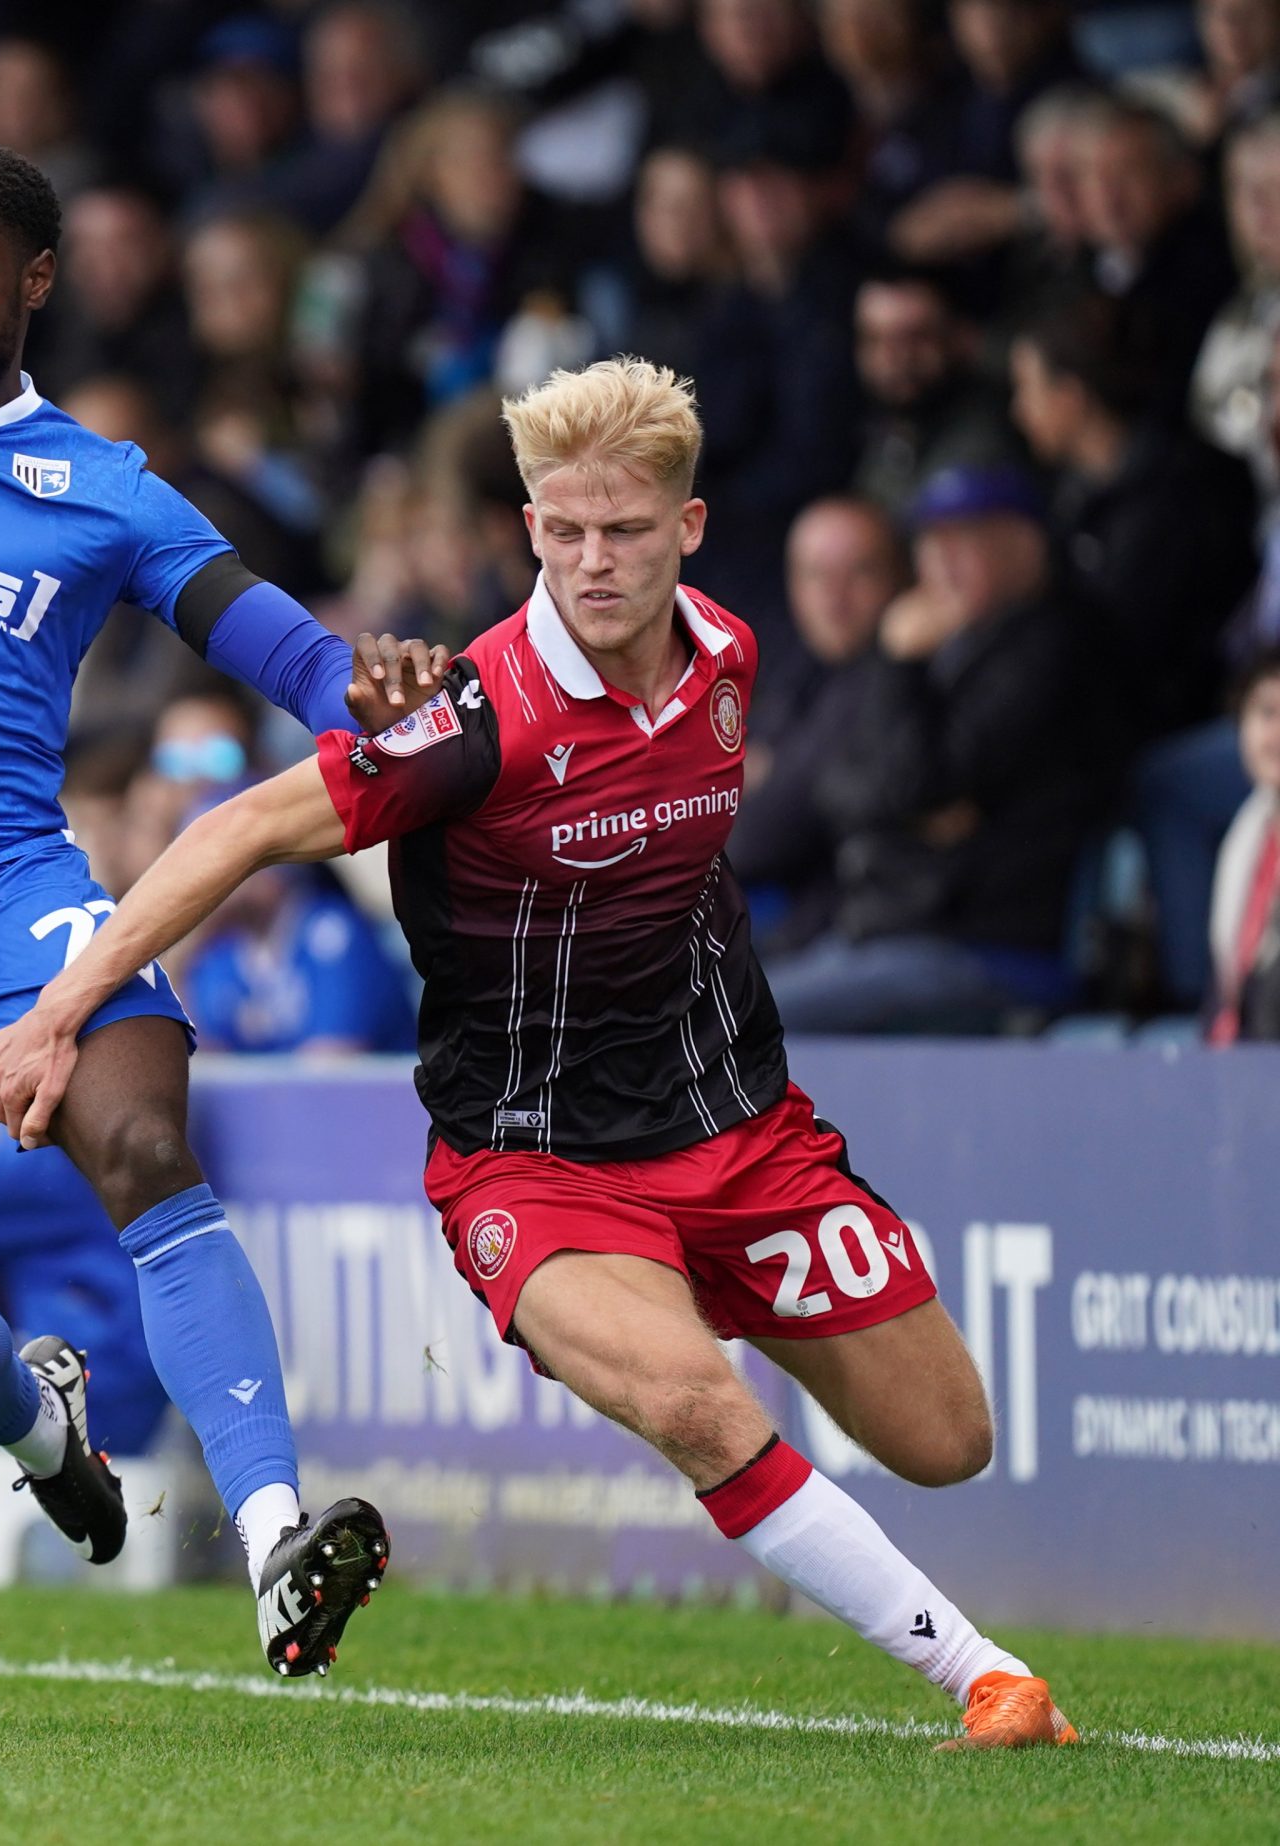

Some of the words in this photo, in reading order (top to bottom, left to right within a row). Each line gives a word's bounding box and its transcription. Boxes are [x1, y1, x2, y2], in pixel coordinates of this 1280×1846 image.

[424, 720, 437, 739] TWO
[434, 709, 451, 731] bet
[551, 807, 648, 851] prime
[654, 786, 739, 832] gaming
[745, 1204, 890, 1318] 20
